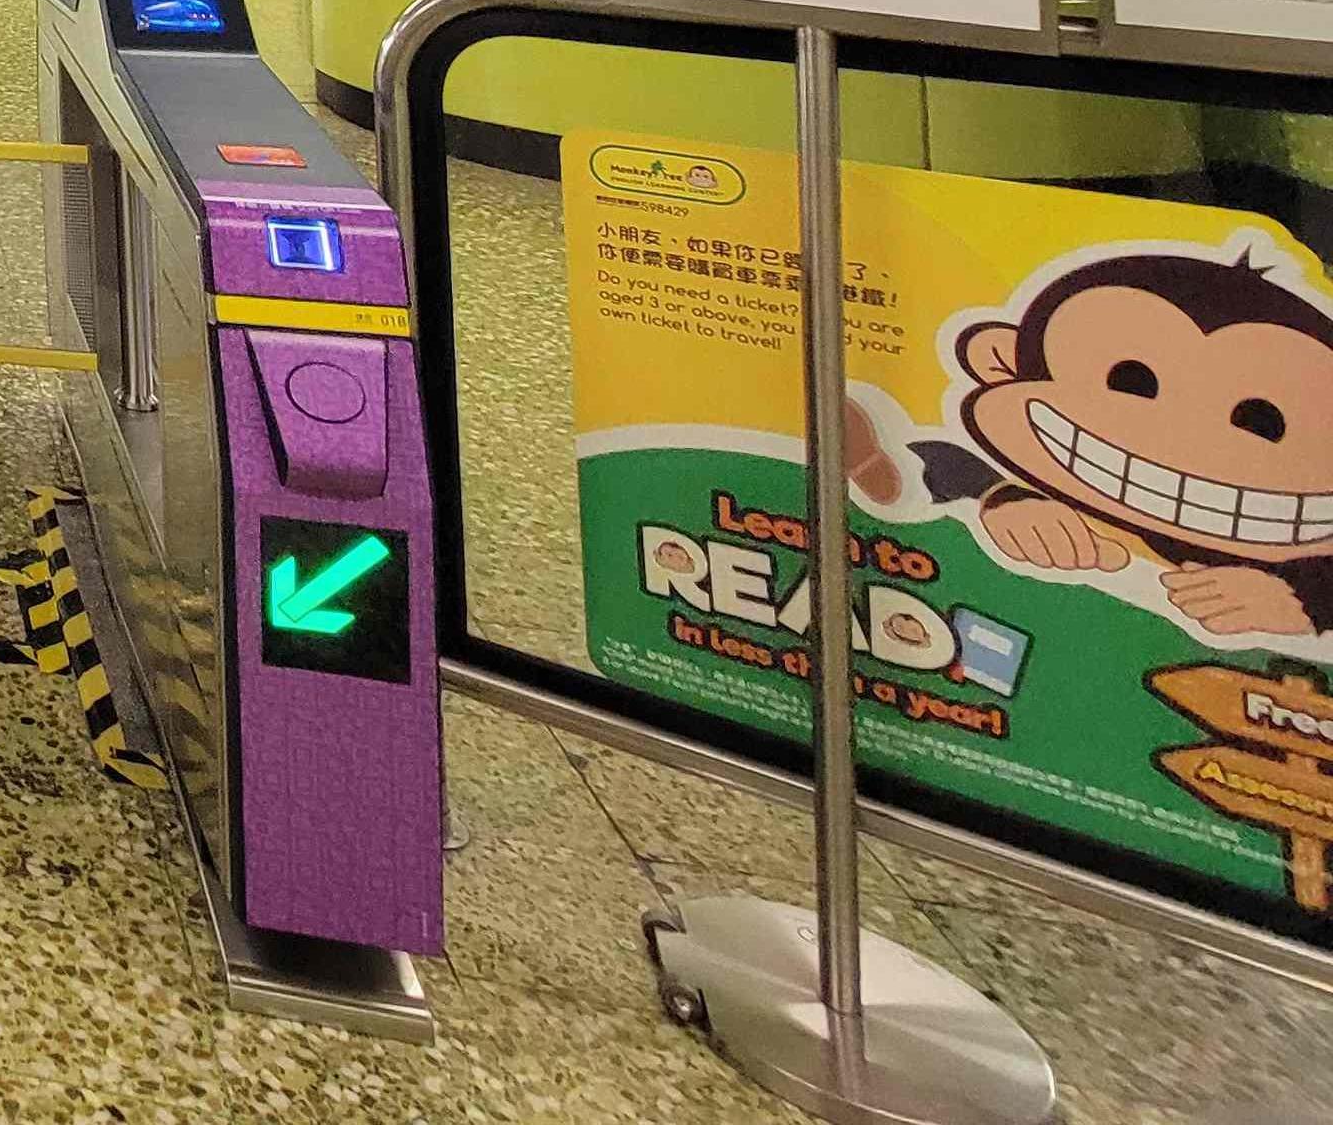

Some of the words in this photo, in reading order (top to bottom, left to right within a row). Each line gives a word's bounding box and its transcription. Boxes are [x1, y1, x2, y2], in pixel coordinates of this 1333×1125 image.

[597, 270, 621, 285] Do
[627, 277, 659, 292] you
[664, 283, 711, 301] need
[717, 293, 729, 305] a
[736, 294, 799, 318] ticket?
[868, 322, 905, 337] are
[599, 289, 643, 306] aged
[649, 296, 659, 309] 3
[665, 302, 685, 314] or
[760, 319, 796, 335] you
[858, 337, 906, 355] your
[600, 306, 636, 322] own
[641, 311, 691, 334] ticket
[696, 322, 715, 338] to
[721, 326, 782, 350] travel!
[715, 493, 861, 565] Lea
[873, 537, 935, 580] to
[709, 629, 774, 668] less
[872, 681, 897, 703] a
[905, 690, 1004, 737] year!
